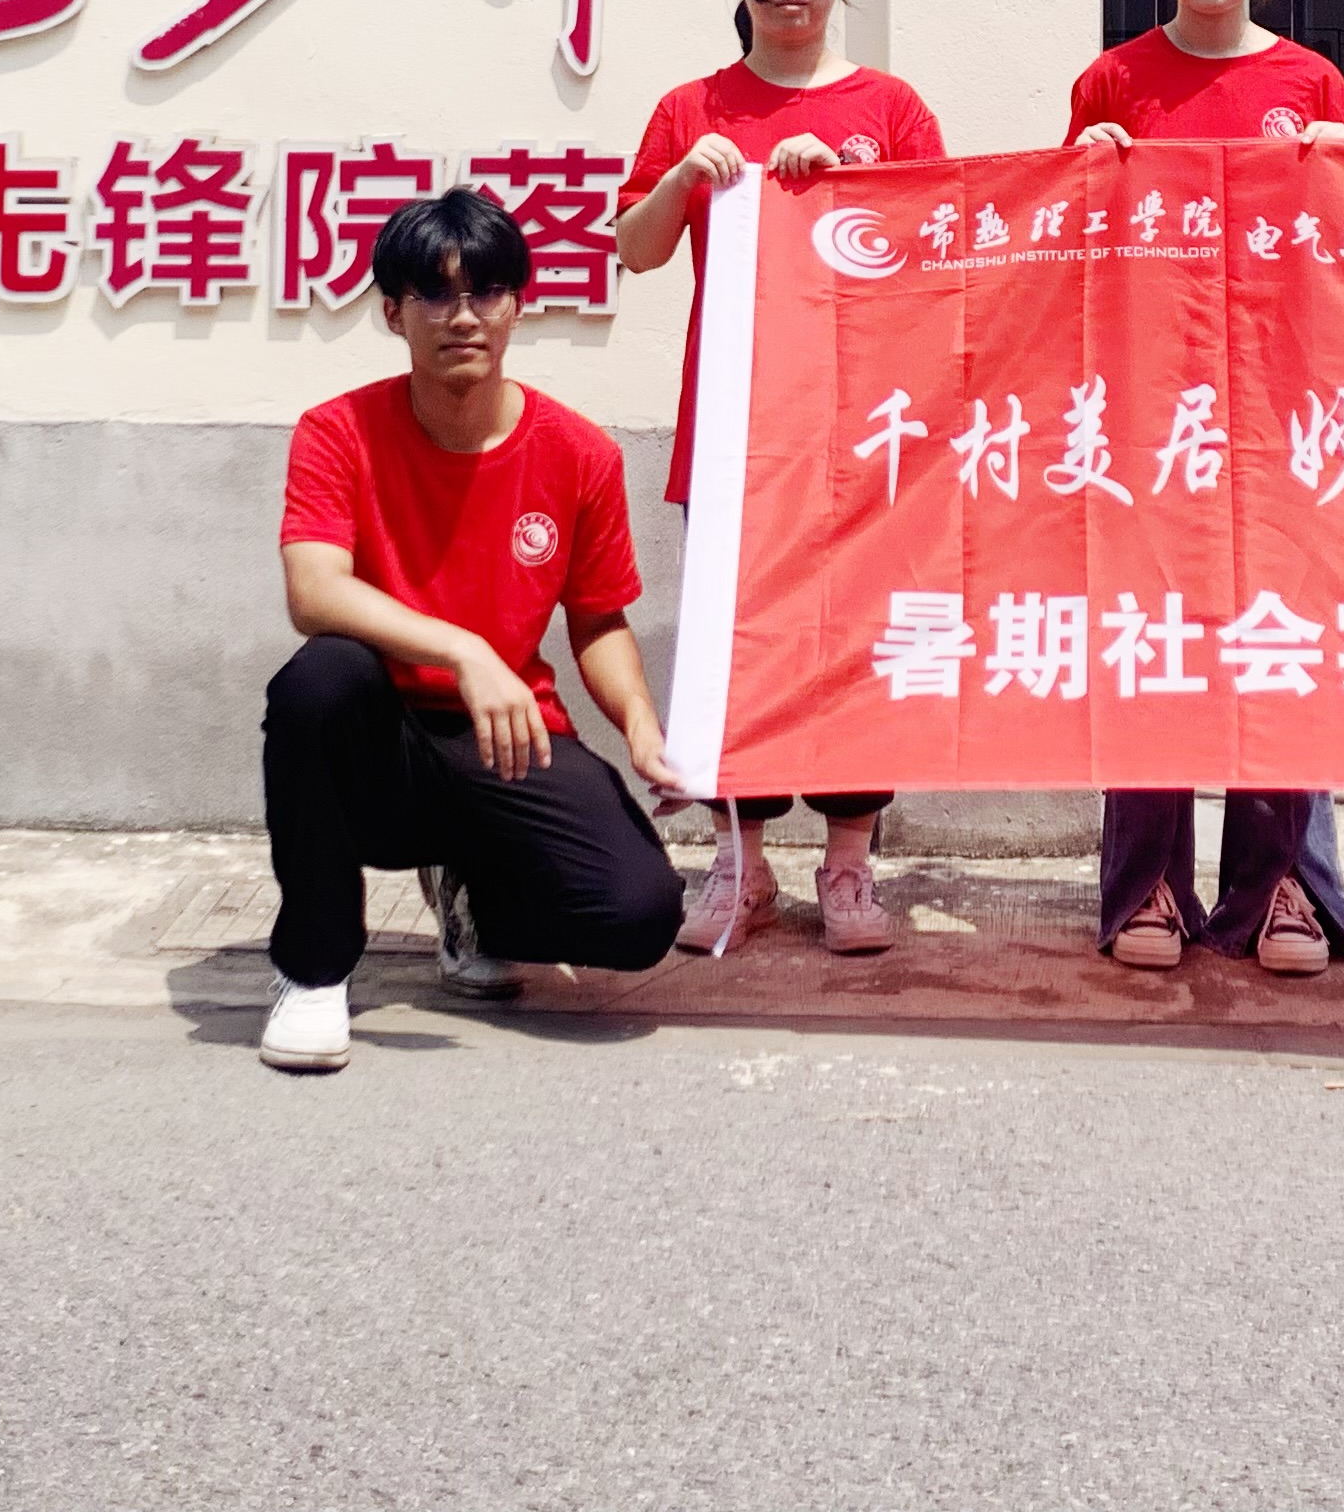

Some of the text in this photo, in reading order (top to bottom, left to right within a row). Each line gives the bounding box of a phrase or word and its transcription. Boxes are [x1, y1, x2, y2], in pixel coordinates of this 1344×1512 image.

[921, 245, 1221, 271] CHANGSHU INSTITUTE OF TECHNOLOGY
[852, 375, 1229, 507] 千村美居
